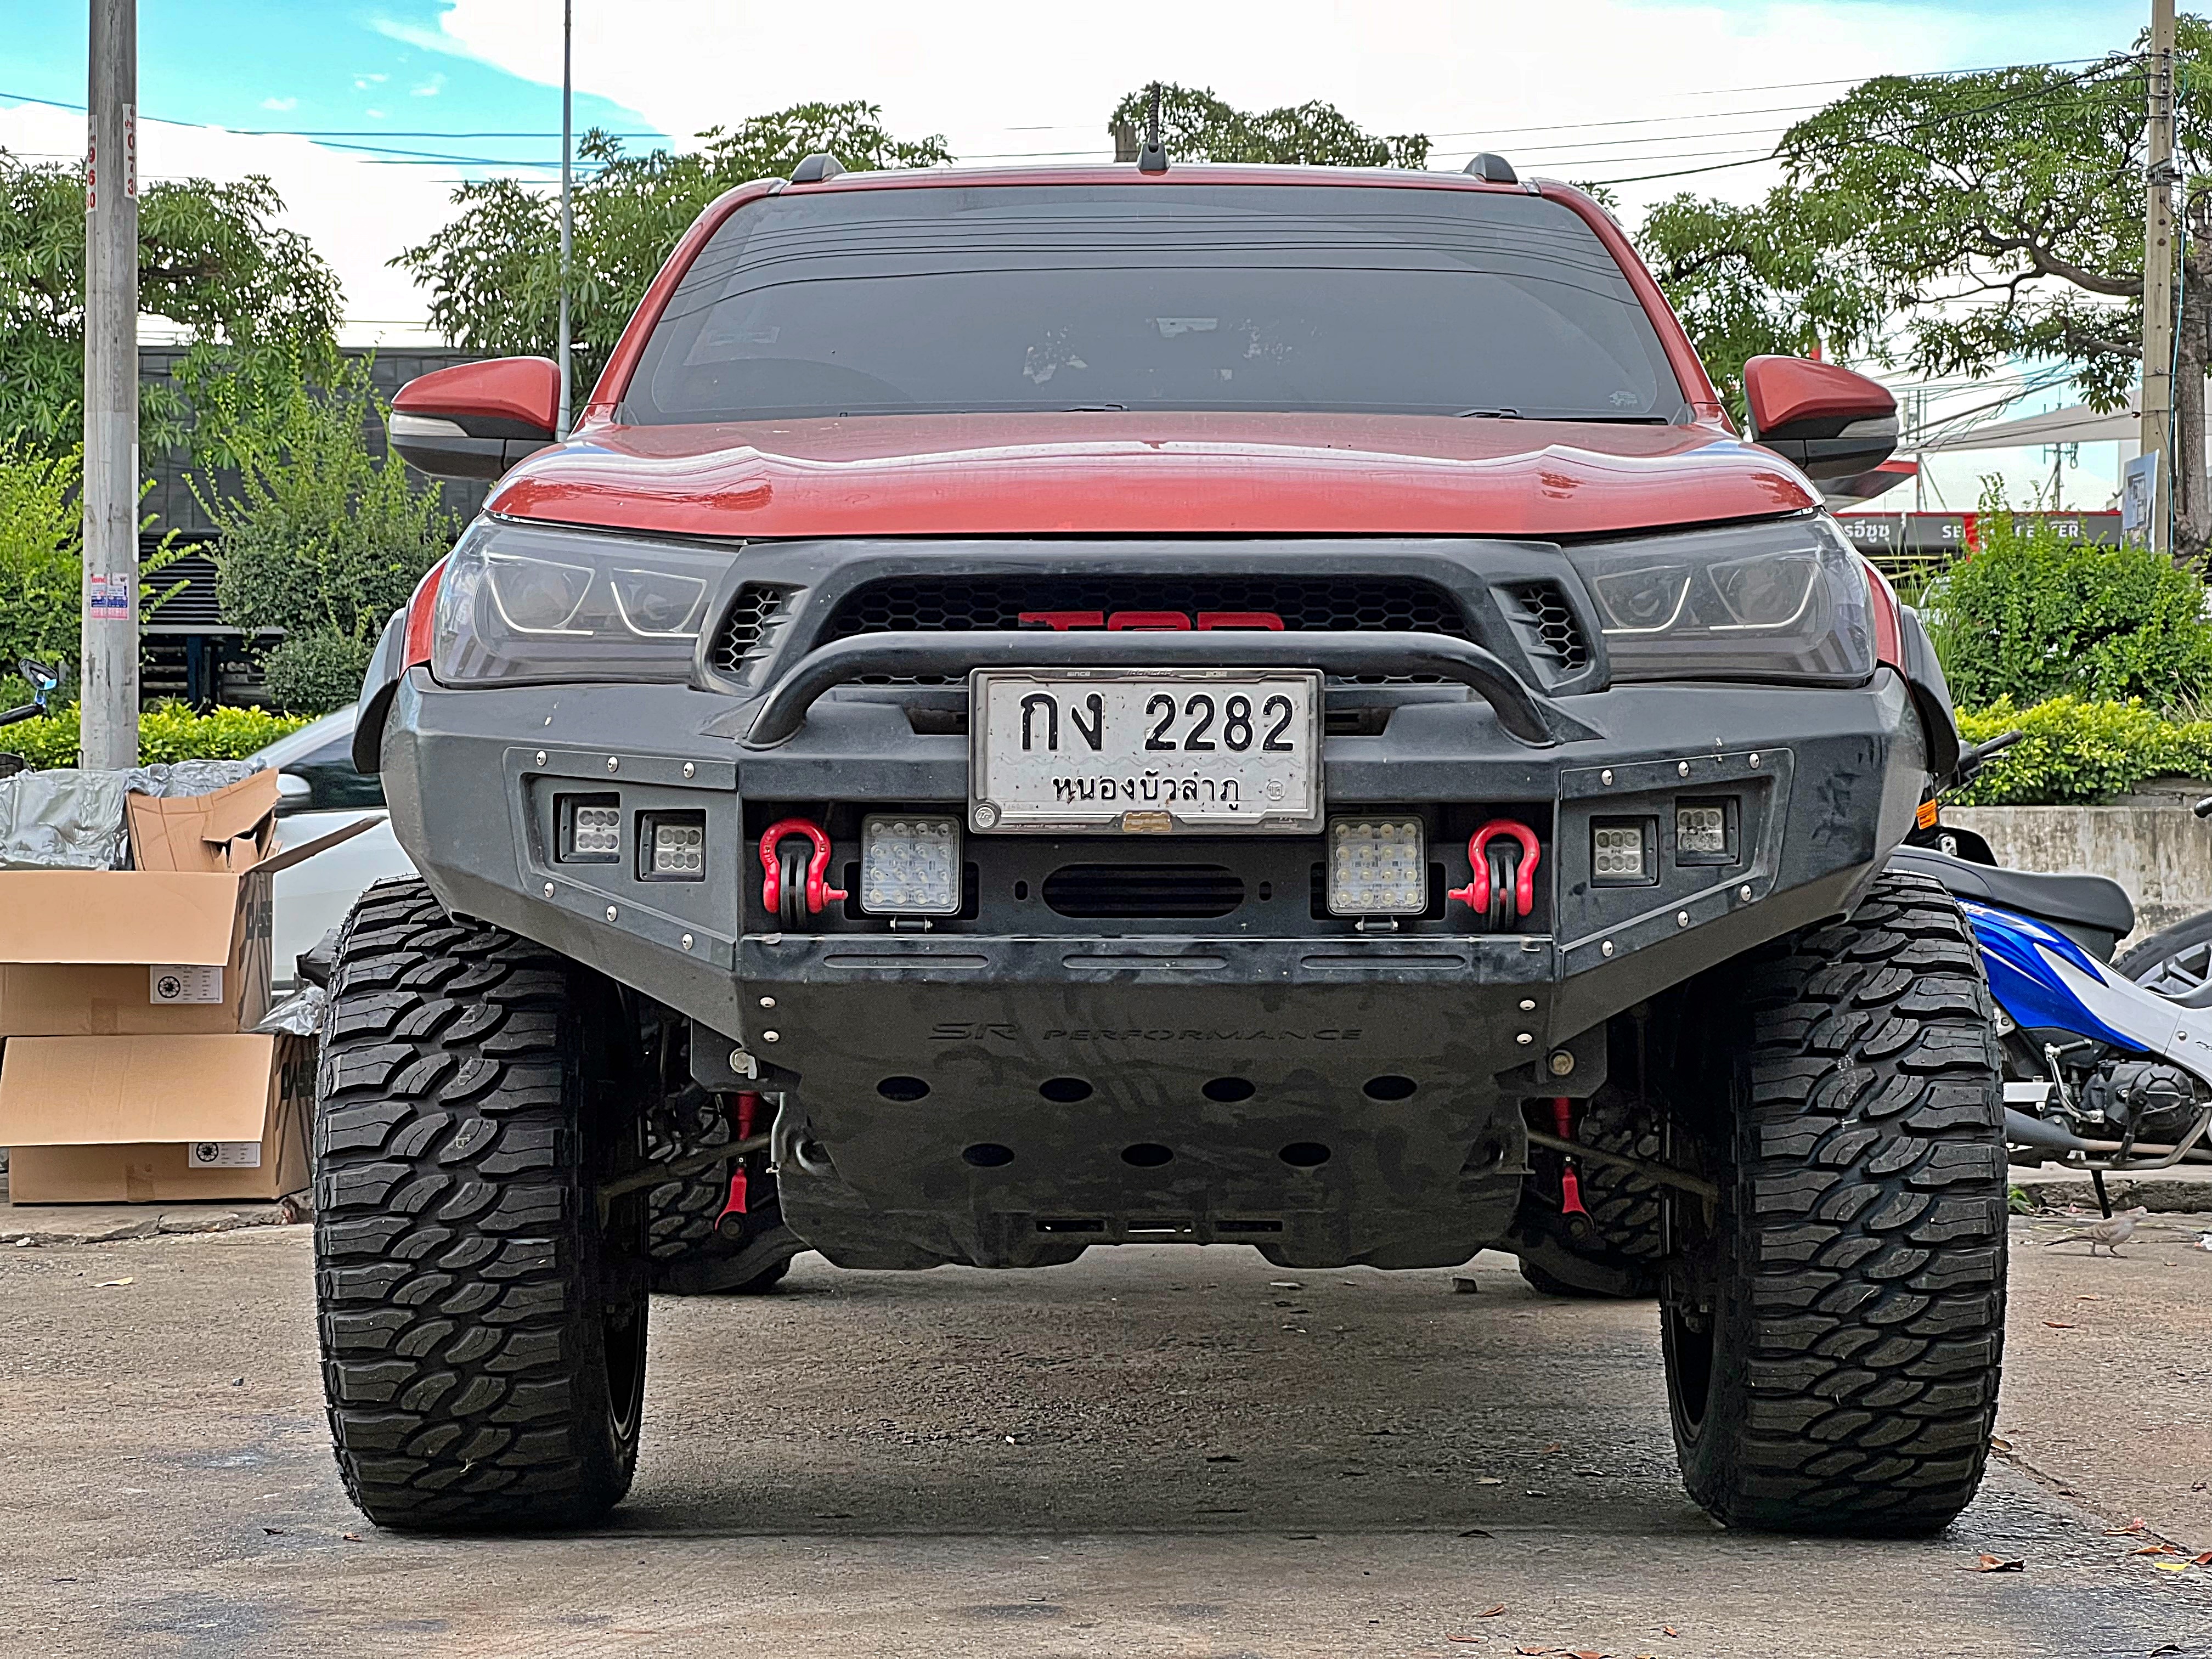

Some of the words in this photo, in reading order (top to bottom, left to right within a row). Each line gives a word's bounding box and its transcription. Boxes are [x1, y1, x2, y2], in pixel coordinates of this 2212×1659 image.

[2016, 524, 2079, 538] EER
[1020, 692, 1103, 751] กง
[1145, 693, 1294, 752] 2282
[1053, 769, 1240, 810] หนองบัวลำภู
[927, 1022, 1020, 1041] SR
[1042, 1029, 1363, 1041] PERFORMANCE
